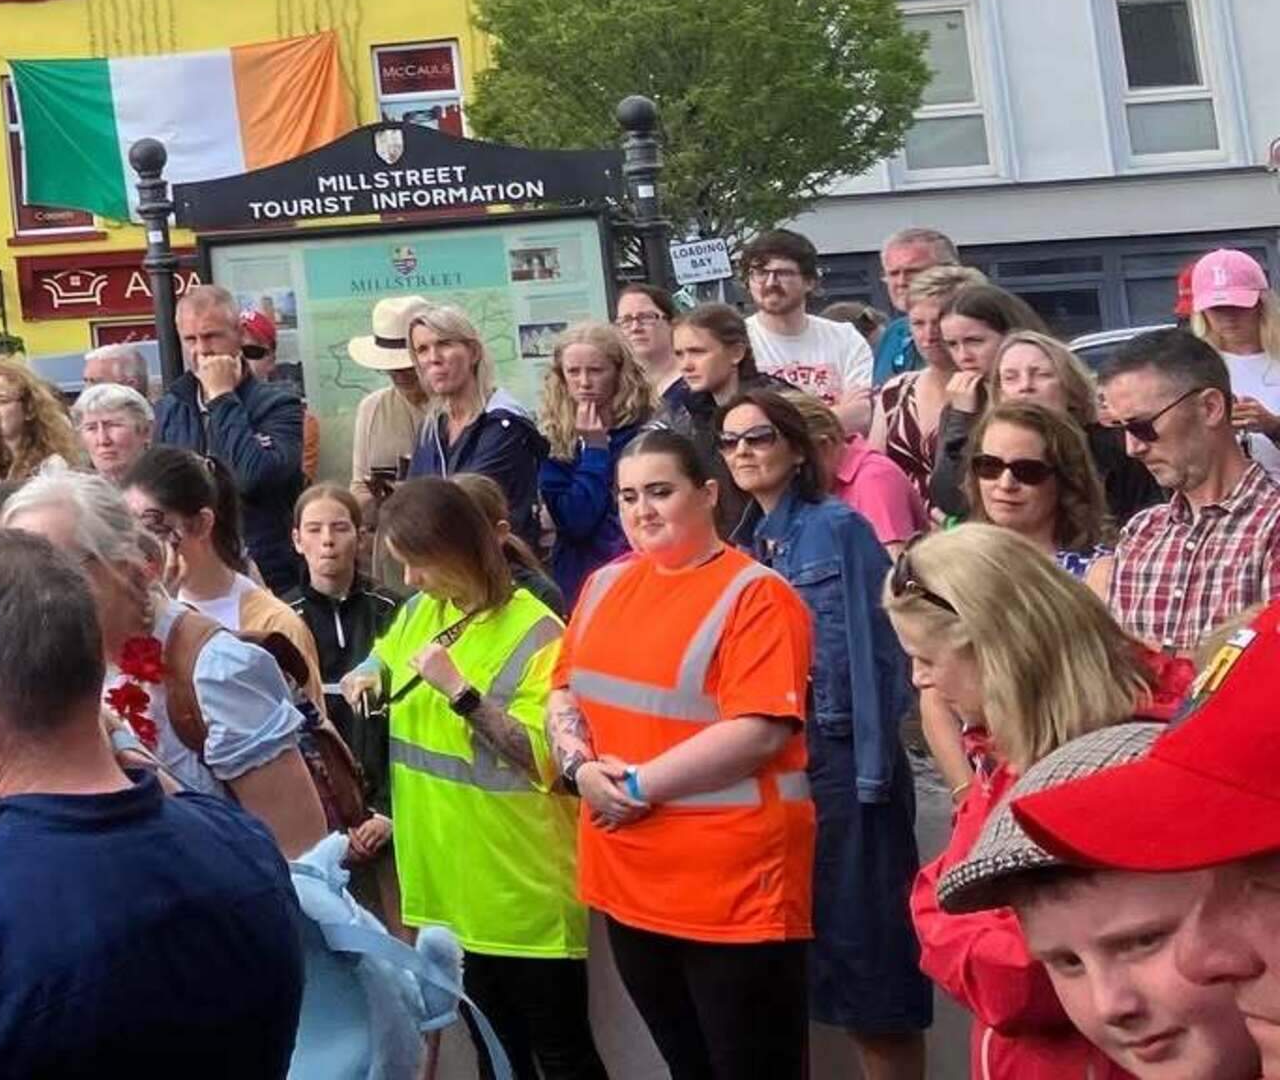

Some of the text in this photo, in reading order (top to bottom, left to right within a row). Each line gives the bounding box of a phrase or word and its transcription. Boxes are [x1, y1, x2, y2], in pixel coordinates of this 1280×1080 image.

[318, 166, 466, 193] MILLSTREET
[249, 180, 545, 219] TOURIST INFORMATION
[673, 242, 724, 260] LOADING
[691, 258, 712, 269] BAY
[351, 273, 463, 294] MILLSTREET
